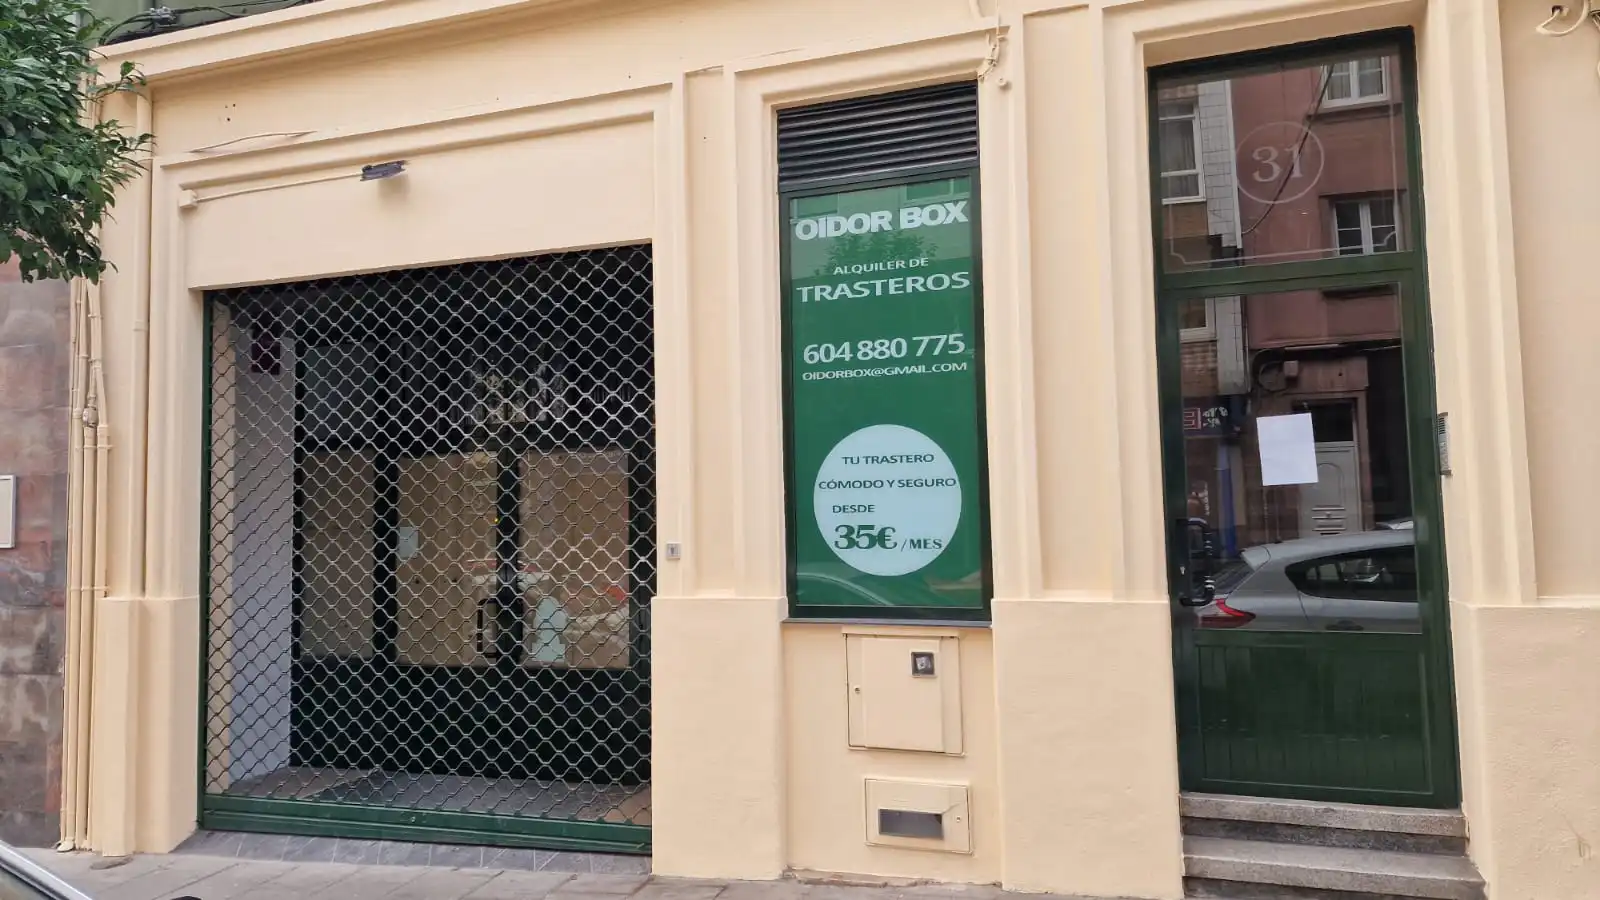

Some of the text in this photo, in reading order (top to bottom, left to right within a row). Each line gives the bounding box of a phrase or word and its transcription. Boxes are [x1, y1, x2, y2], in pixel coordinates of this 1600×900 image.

[1252, 143, 1303, 182] 31
[795, 201, 968, 240] OIDOR BOX
[833, 257, 929, 275] ALQUILER DE
[796, 272, 970, 302] TRASTEROS
[803, 333, 965, 364] 604 880 775
[802, 362, 967, 381] OIDORBOX@GMAIL.COM
[842, 453, 934, 465] TU TRASTERO
[818, 478, 957, 490] CÓMODO Y SEGURO
[832, 504, 875, 514] DESDE
[834, 524, 898, 550] 35€
